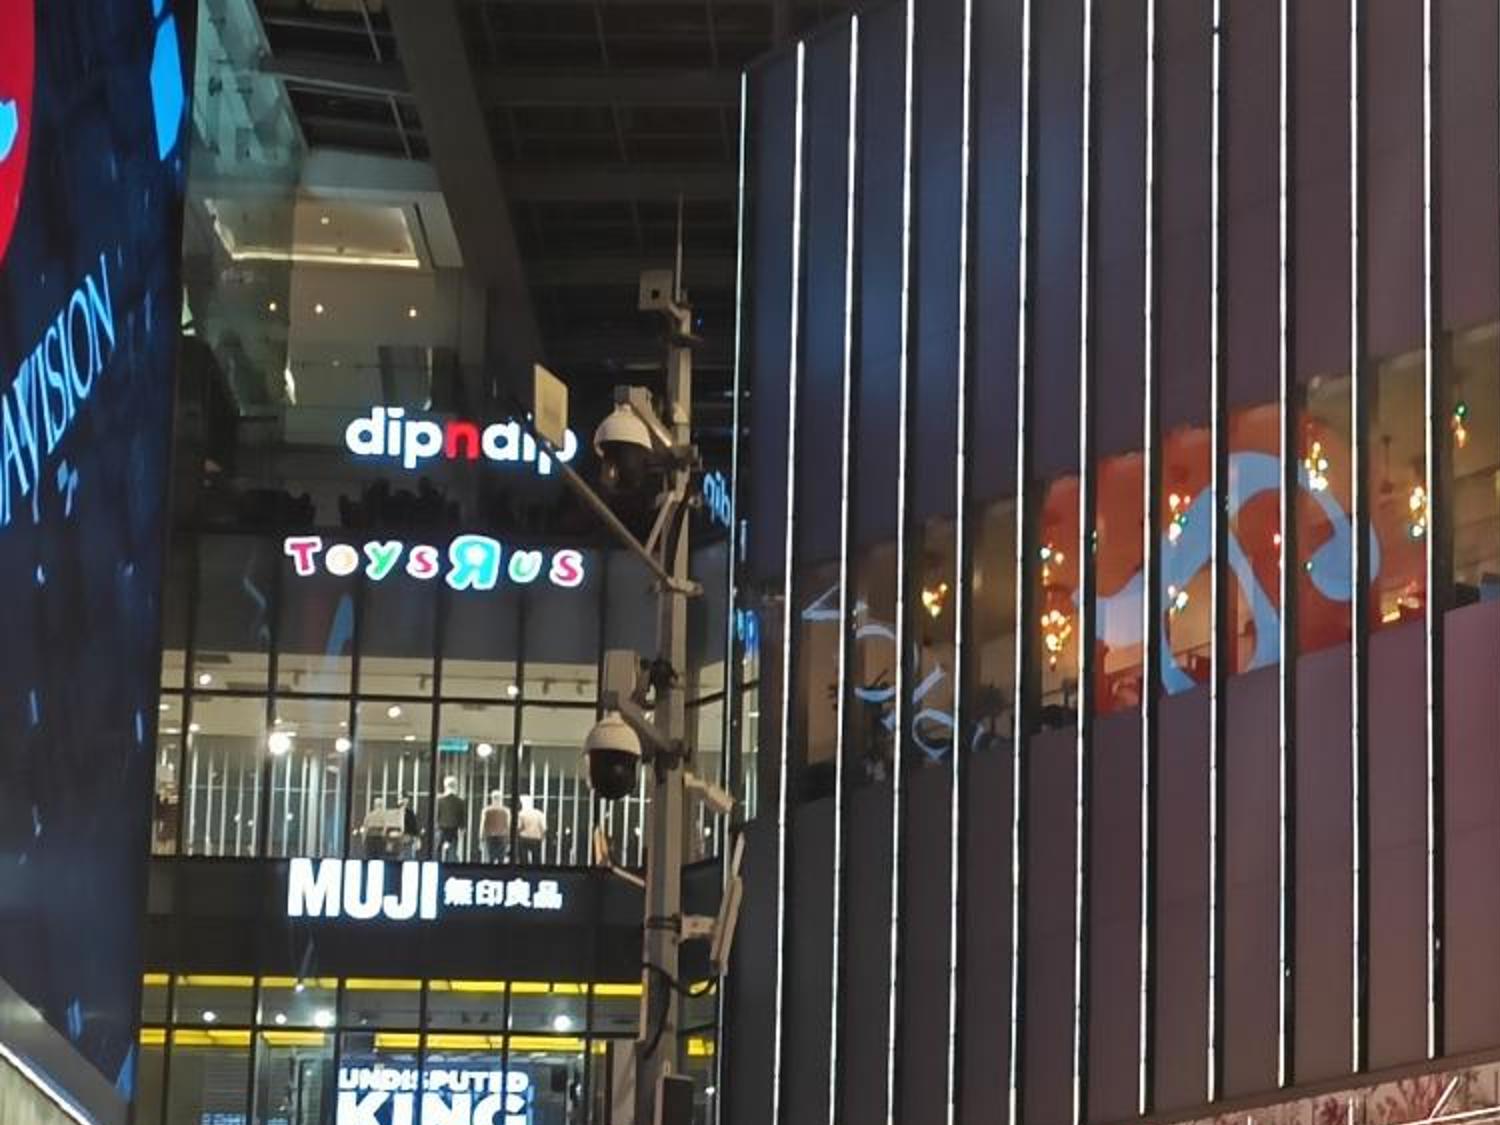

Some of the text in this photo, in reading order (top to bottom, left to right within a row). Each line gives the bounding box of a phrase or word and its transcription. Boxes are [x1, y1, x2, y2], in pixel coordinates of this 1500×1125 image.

[287, 857, 440, 920] MUJI
[444, 876, 563, 909] 無印良品
